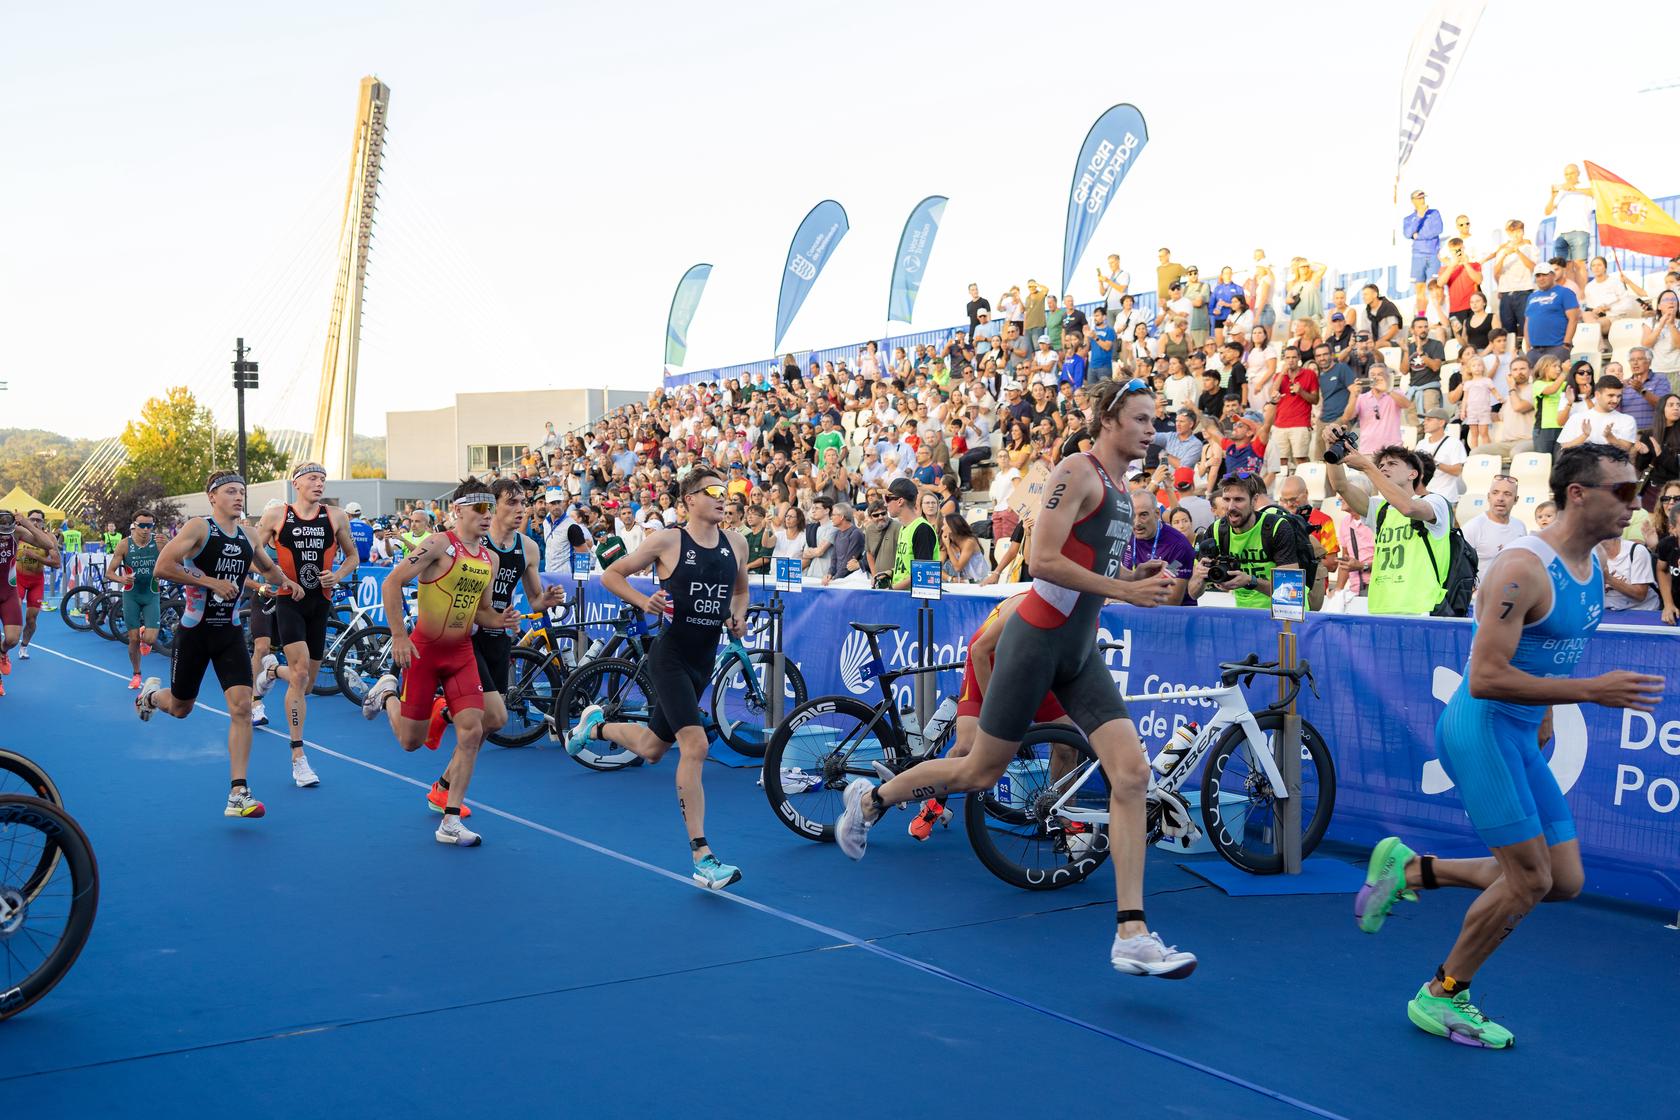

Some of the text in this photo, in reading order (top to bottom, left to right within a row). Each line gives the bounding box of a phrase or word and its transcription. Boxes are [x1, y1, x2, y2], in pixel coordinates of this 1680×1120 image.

[1074, 139, 1114, 204] GALICIA
[1086, 132, 1139, 213] CALIDADE
[294, 540, 304, 549] van
[301, 551, 318, 561] NED
[137, 567, 150, 575] POR
[215, 558, 245, 573] MARTI
[468, 566, 489, 575] SUZUKI
[781, 567, 786, 577] 7
[917, 571, 922, 582] 5
[494, 581, 508, 595] UX
[690, 582, 729, 599] PYE
[453, 594, 476, 609] ESP
[694, 599, 721, 614] GBR
[1500, 601, 1514, 620] 7
[291, 708, 299, 727] 56
[1139, 710, 1168, 738] de
